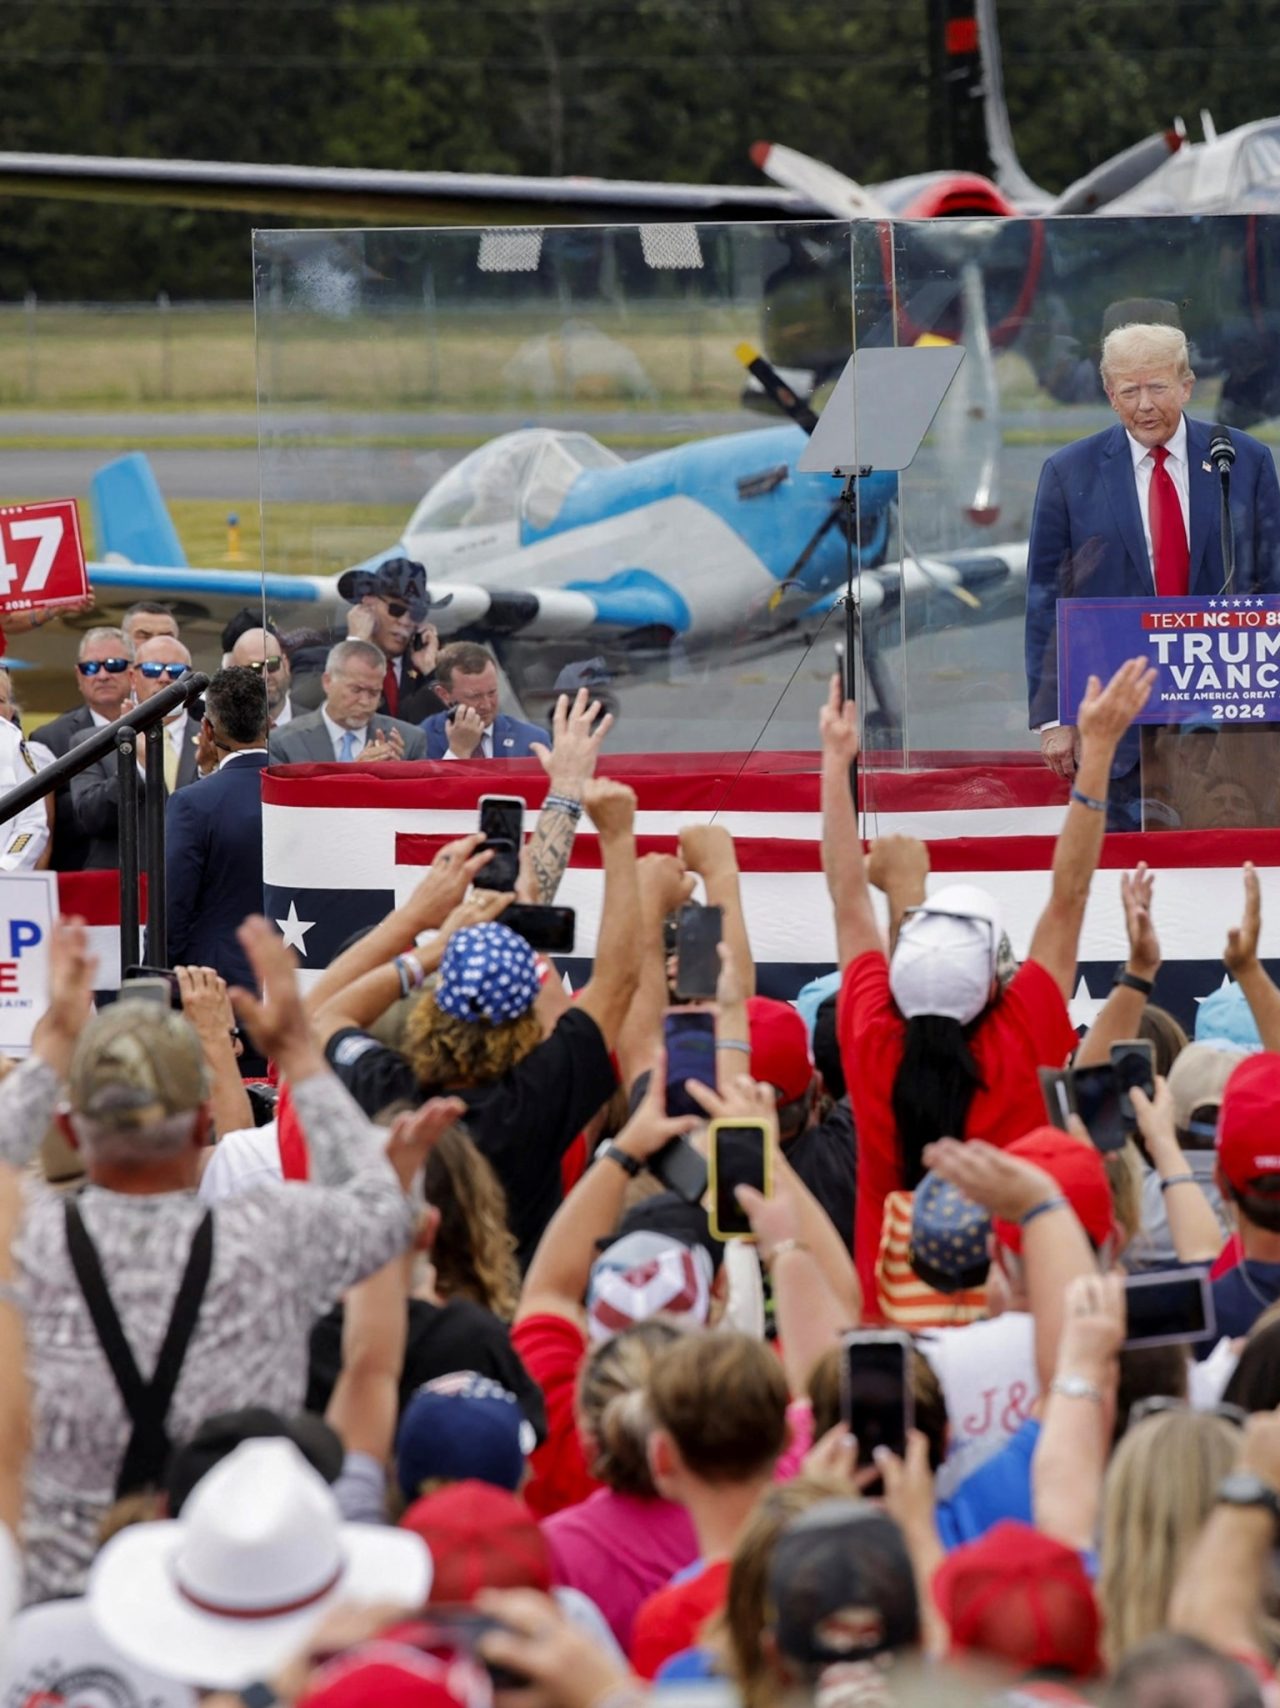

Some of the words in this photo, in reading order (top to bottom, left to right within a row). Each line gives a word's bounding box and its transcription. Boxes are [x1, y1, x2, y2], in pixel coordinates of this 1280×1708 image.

[1150, 612, 1197, 628] TEXT
[1203, 612, 1230, 627] NC
[1235, 611, 1261, 627] TO
[1161, 692, 1190, 701] MAKE
[1193, 691, 1239, 700] AMERICA
[1242, 690, 1276, 699] GREAT
[1212, 703, 1266, 720] 2024
